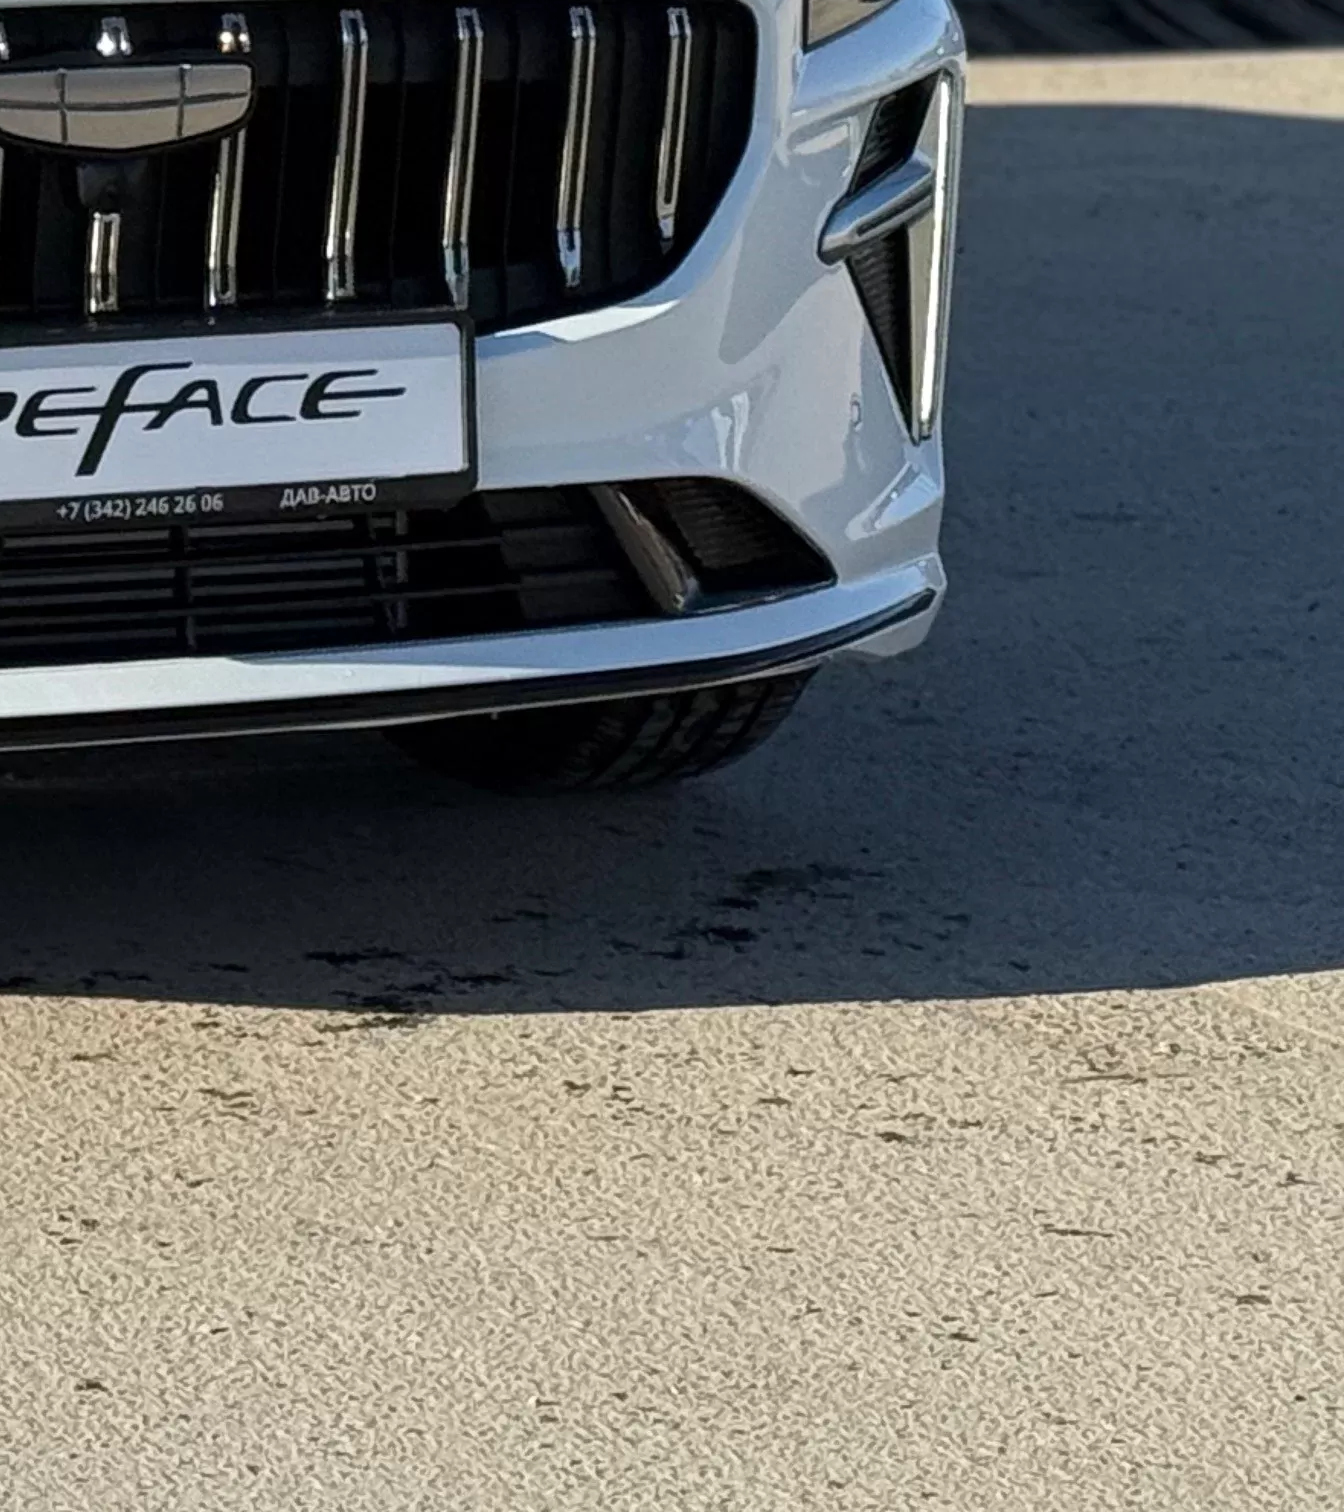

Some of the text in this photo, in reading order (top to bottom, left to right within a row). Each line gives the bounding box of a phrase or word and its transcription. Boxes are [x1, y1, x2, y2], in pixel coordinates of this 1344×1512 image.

[56, 493, 224, 521] +7 (342) 246 26 06
[279, 483, 377, 510] ДАВ-АВТО
